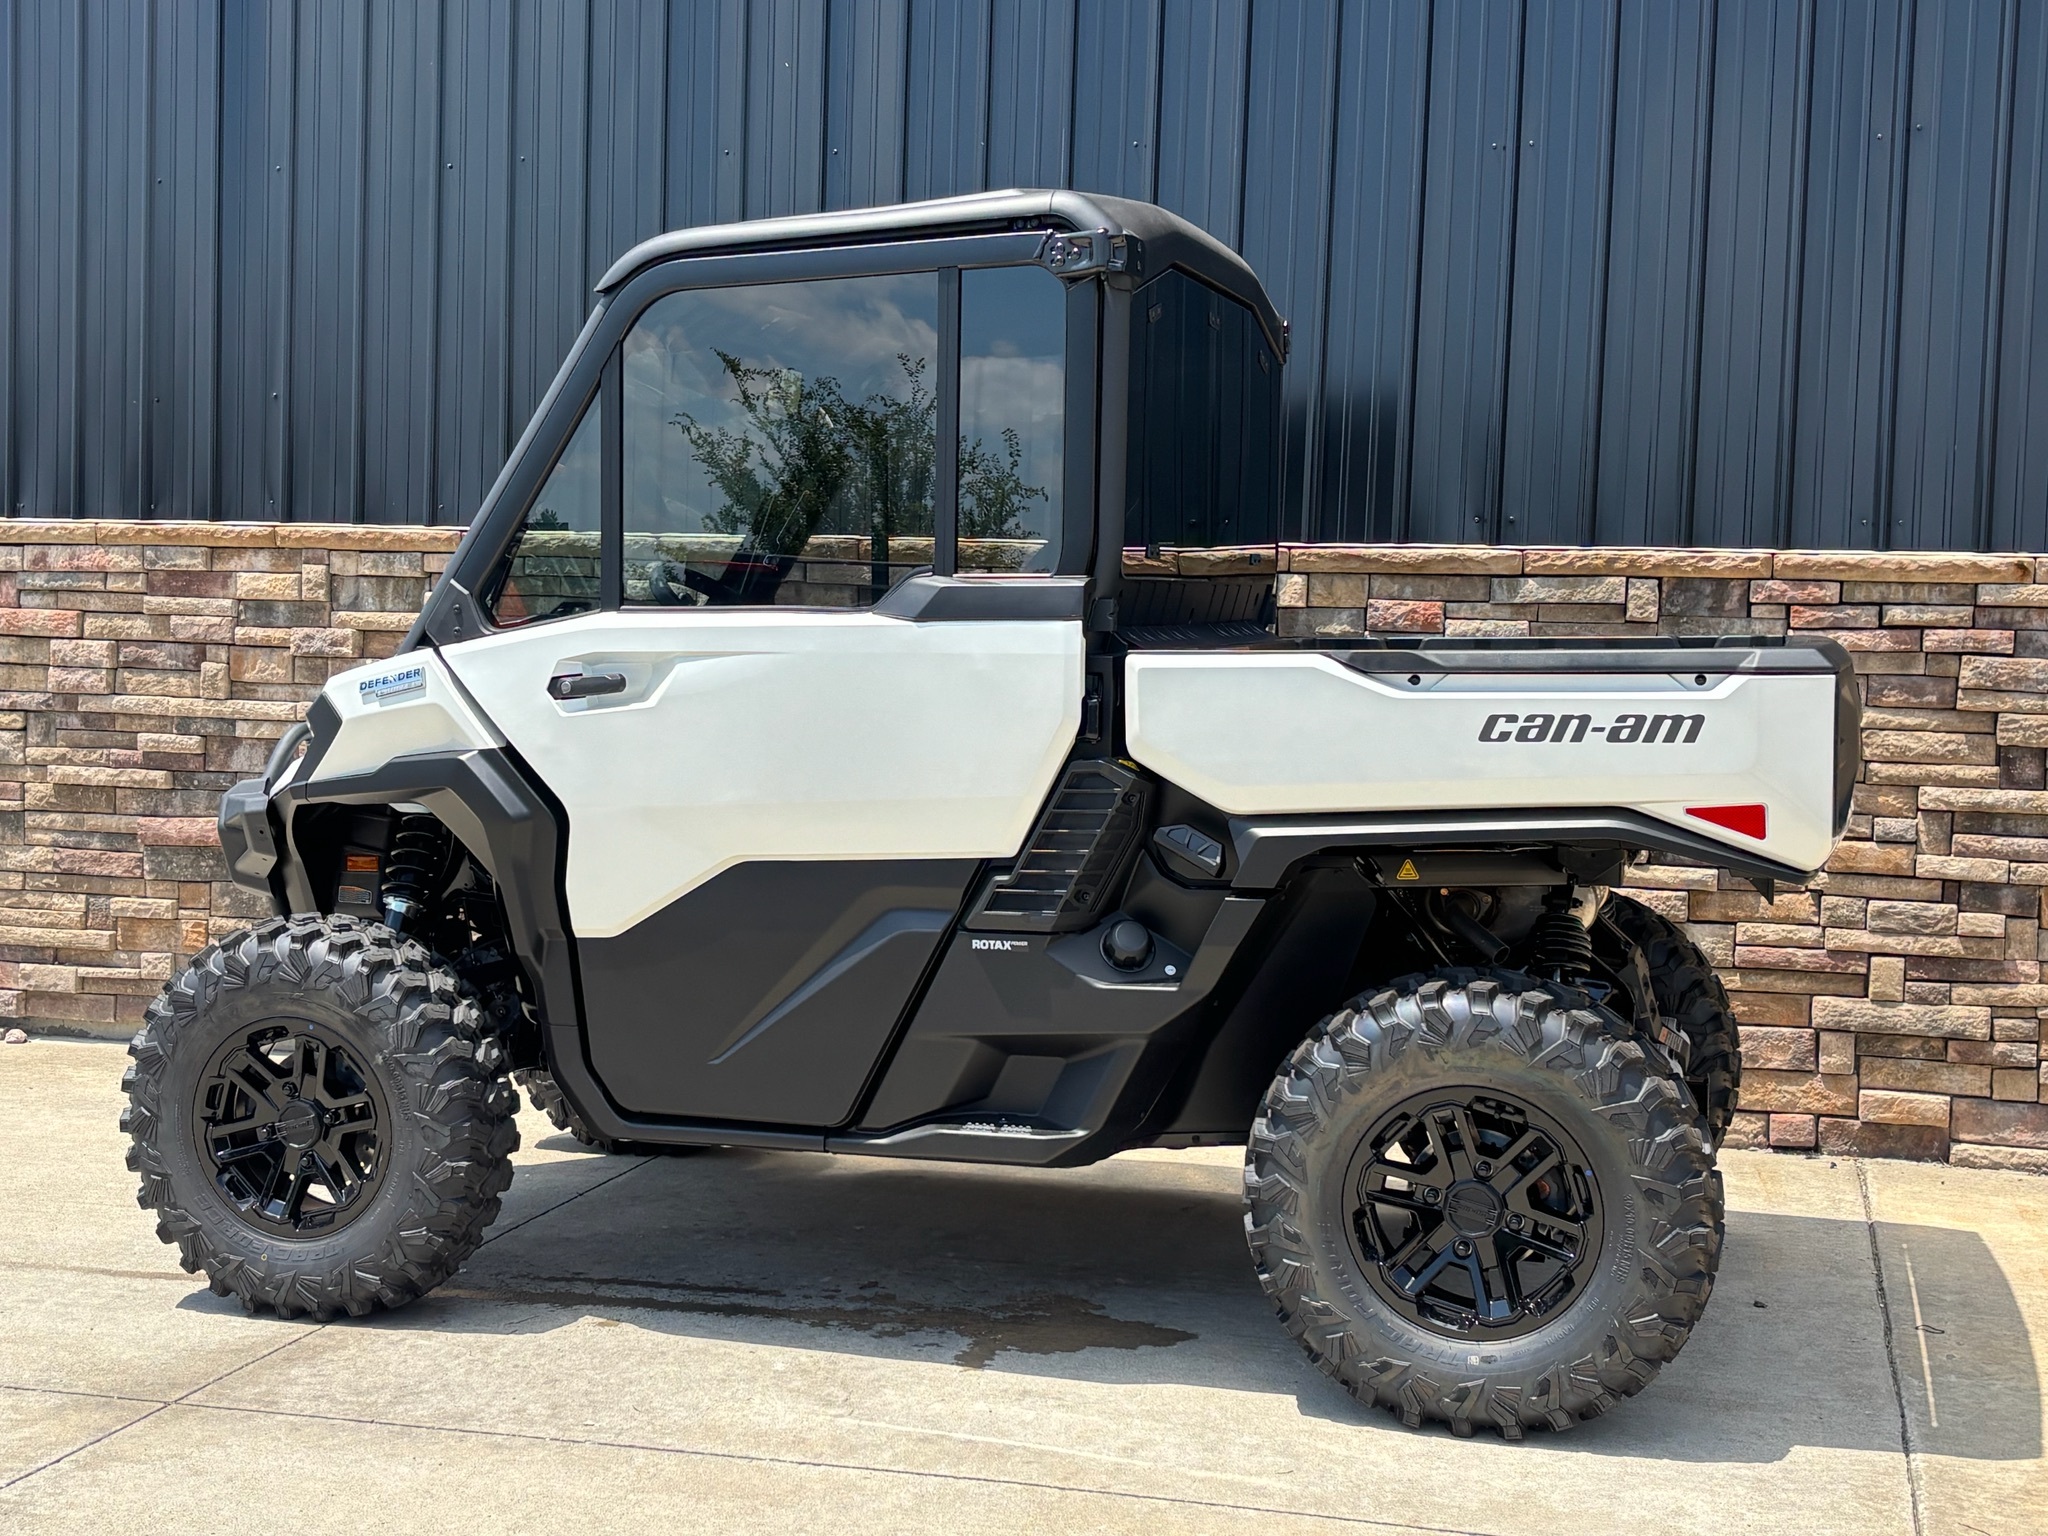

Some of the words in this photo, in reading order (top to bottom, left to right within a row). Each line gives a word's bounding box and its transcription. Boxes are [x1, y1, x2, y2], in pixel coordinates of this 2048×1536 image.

[359, 668, 421, 691] DEFENDER
[1478, 714, 1706, 743] can-am
[972, 939, 1012, 951] ROTAX
